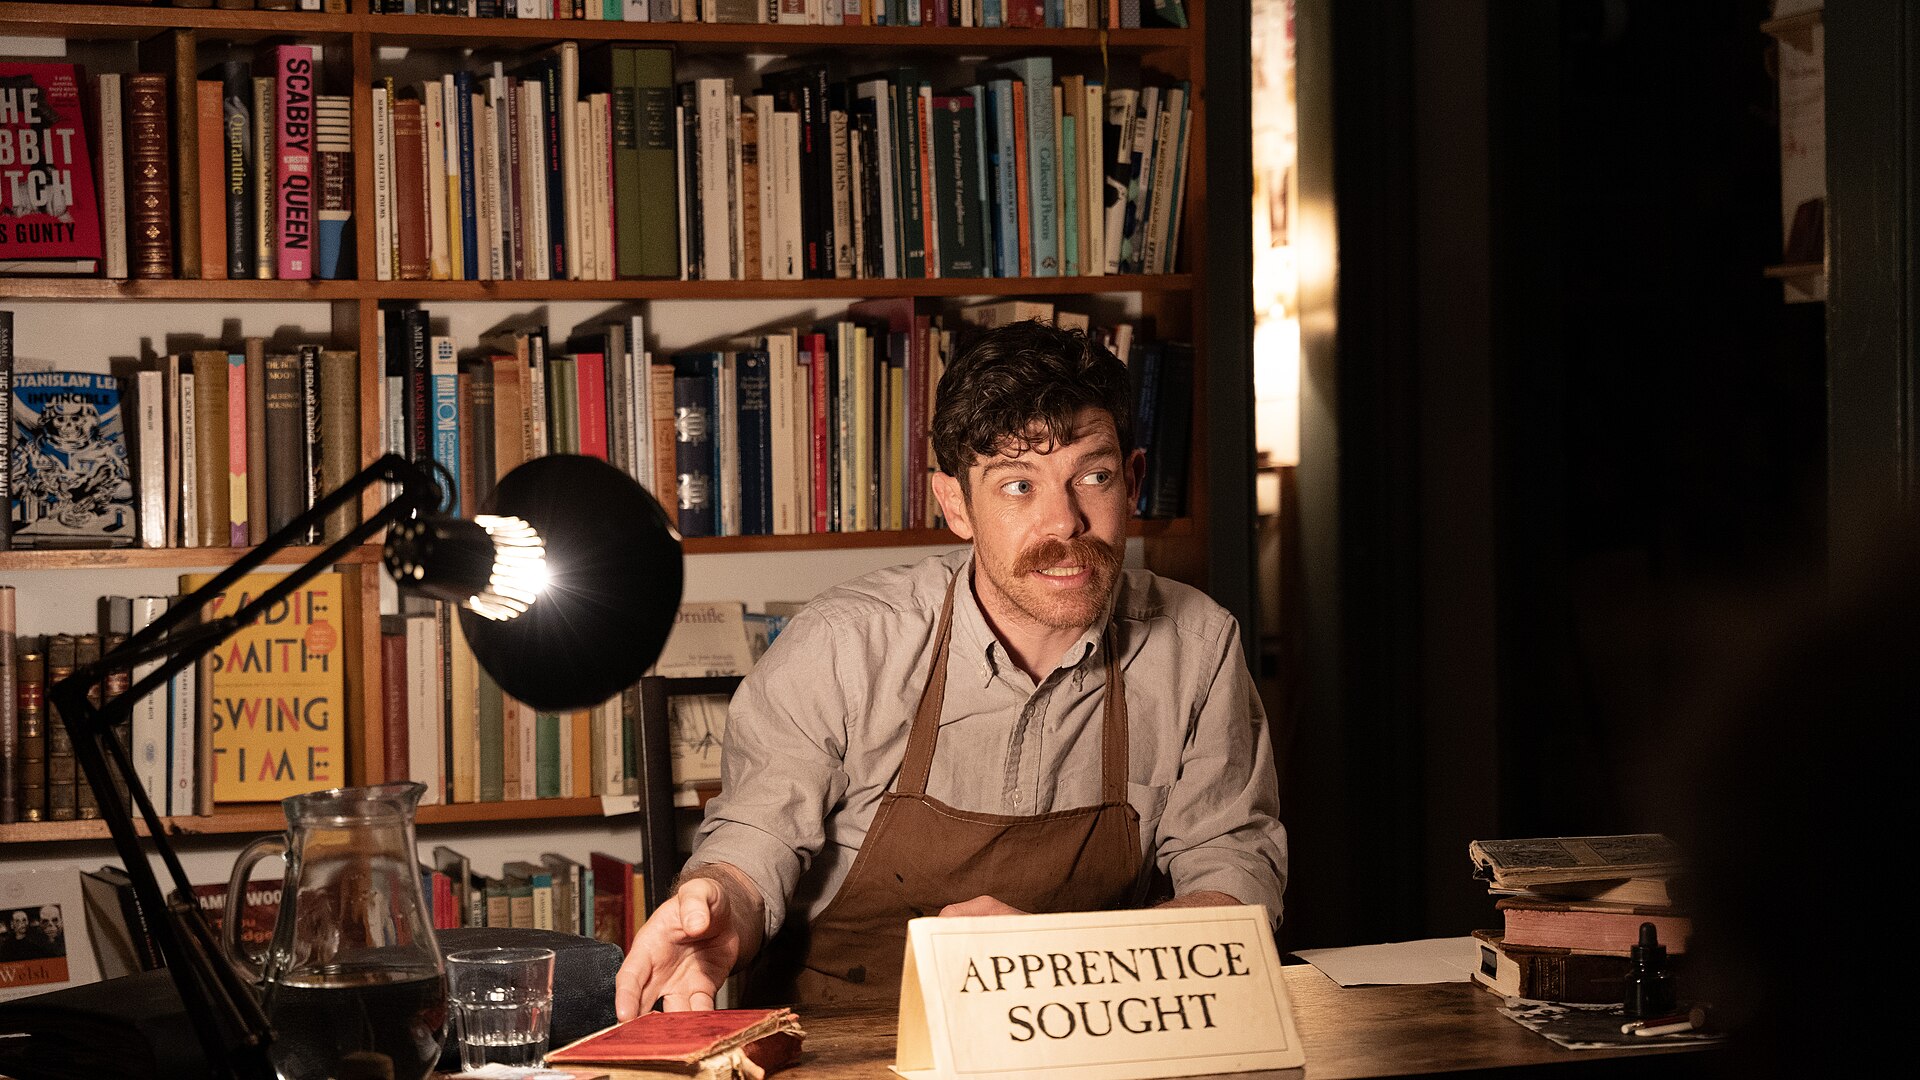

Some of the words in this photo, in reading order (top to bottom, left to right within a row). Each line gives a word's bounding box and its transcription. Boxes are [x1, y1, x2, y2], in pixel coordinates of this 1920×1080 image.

[286, 58, 311, 153] SCABBY
[833, 114, 847, 148] SIXTY
[230, 113, 247, 195] Quarantine
[378, 154, 386, 191] SELECTED
[836, 152, 848, 191] POEMS
[0, 169, 73, 207] TCH
[1040, 147, 1052, 201] Collected
[283, 174, 310, 250] QUEEN
[1041, 203, 1054, 241] Poems
[16, 222, 76, 243] GUNTY
[305, 352, 314, 367] THE
[413, 326, 424, 368] MILTON
[13, 373, 91, 388] STANISLAW
[28, 393, 111, 405] INVINCIBLE
[415, 372, 425, 419] PARADISE
[184, 386, 193, 424] DILATION
[437, 377, 456, 430] MILTON
[185, 426, 193, 458] EFFECT
[307, 405, 316, 444] REVENGE
[416, 424, 425, 451] LOST
[438, 432, 448, 465] Shorte
[4, 675, 12, 711] PEDRO
[212, 748, 329, 783] TIME
[246, 890, 282, 907] WOO
[960, 942, 1251, 994] APPRENTICE
[1007, 993, 1218, 1042] SOUGHT
